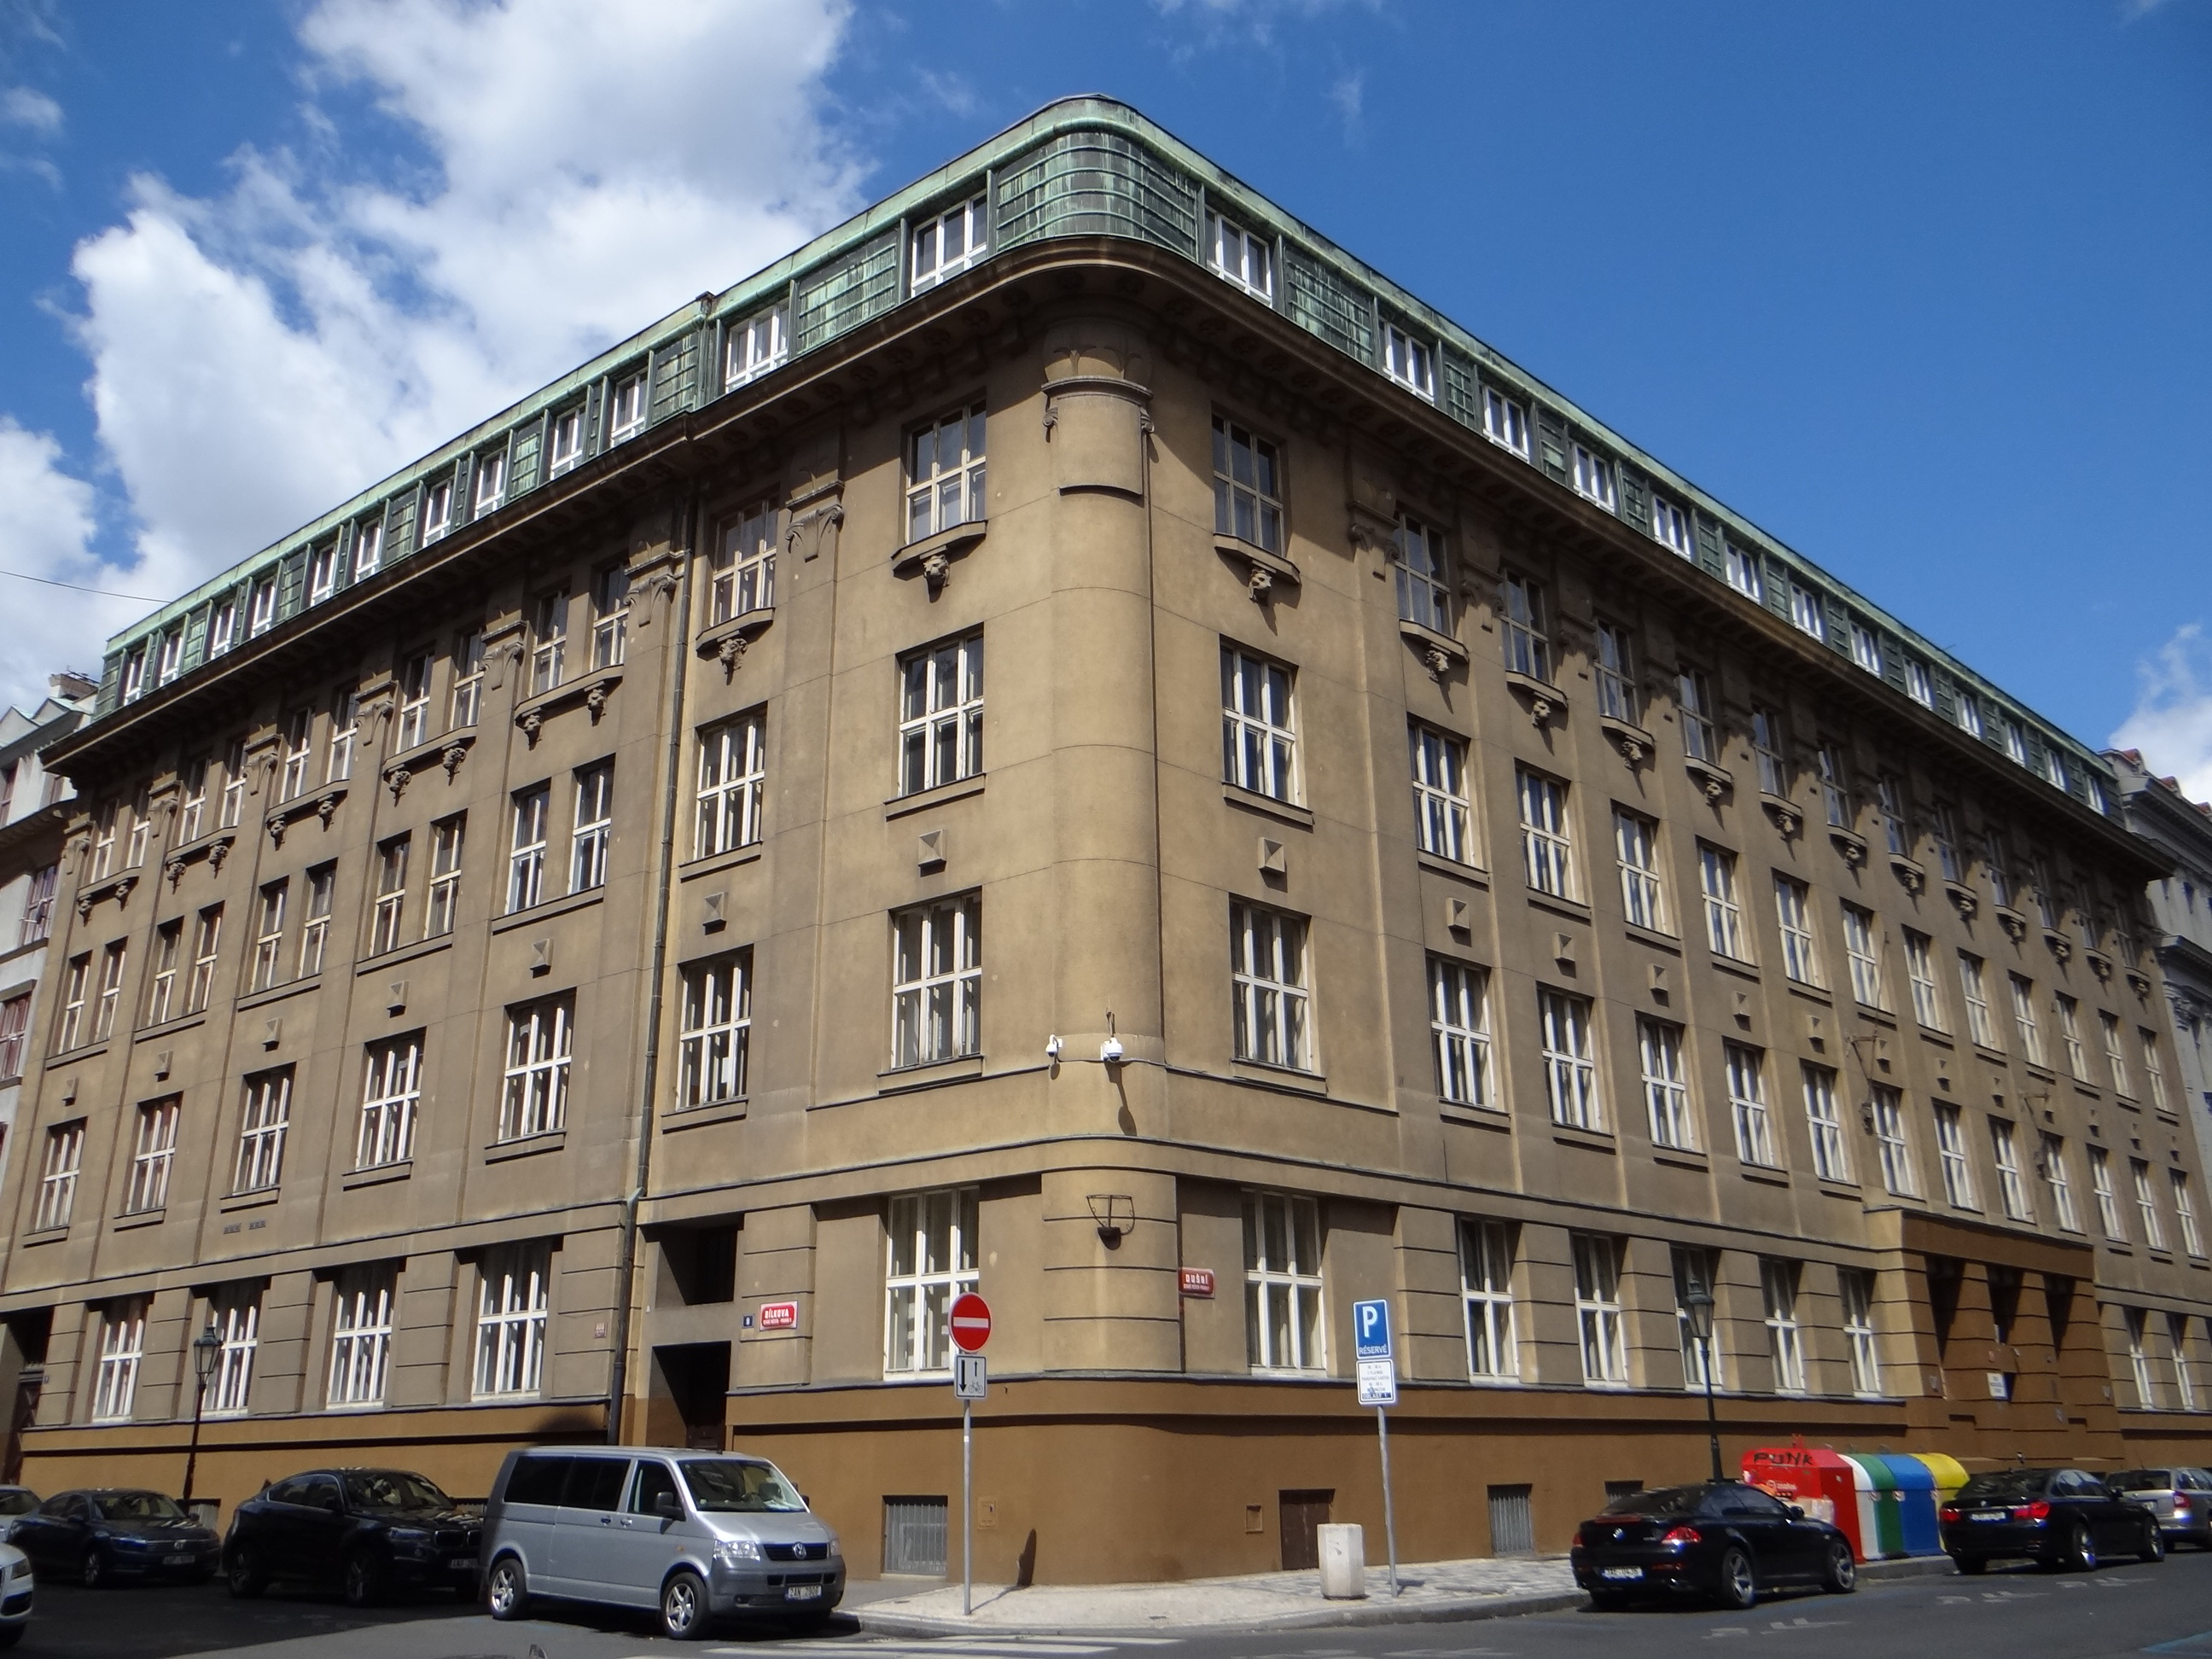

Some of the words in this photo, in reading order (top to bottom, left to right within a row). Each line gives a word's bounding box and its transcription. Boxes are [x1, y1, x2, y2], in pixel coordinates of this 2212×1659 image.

[1185, 1272, 1208, 1284] DUŠNÍ
[765, 1307, 789, 1319] BÍLKOVA
[1362, 1306, 1377, 1337] P
[1359, 1343, 1388, 1355] RÉSERVÉ
